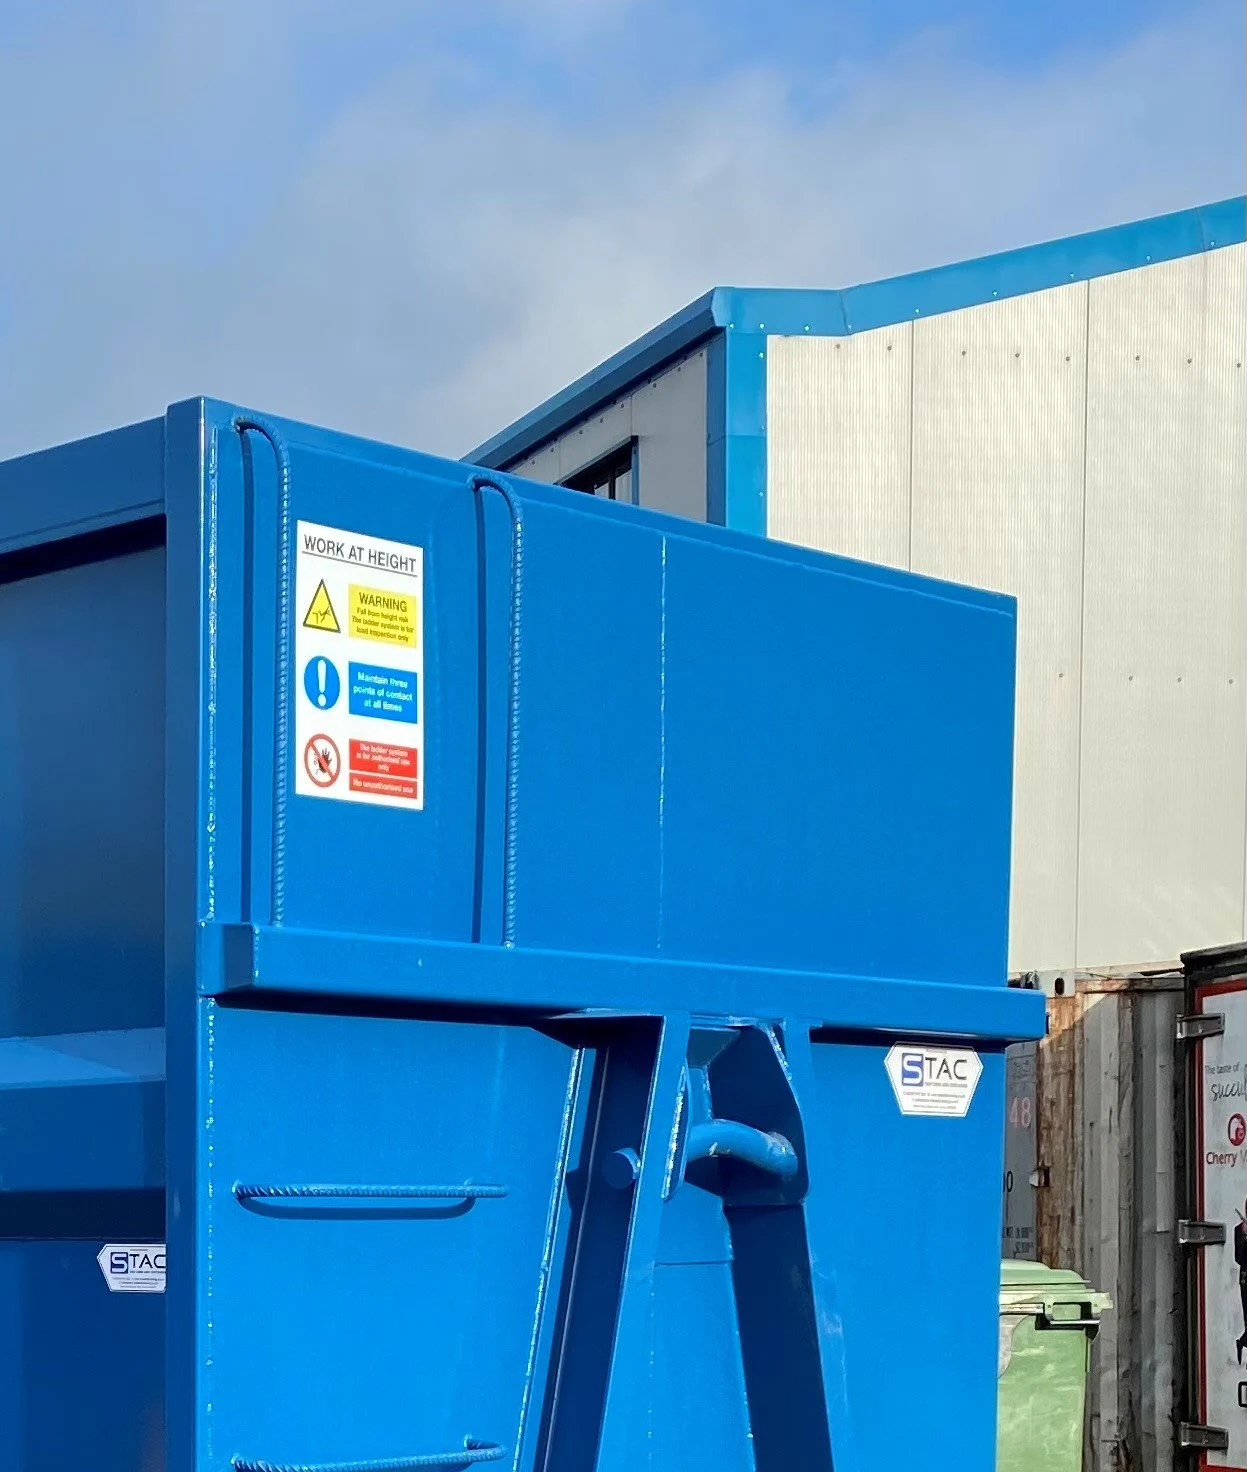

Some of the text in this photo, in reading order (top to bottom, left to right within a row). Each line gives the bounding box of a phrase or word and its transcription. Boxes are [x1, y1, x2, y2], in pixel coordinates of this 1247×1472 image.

[303, 534, 417, 573] WORK AT HEIGHT
[358, 592, 408, 613] WARNING
[351, 615, 362, 624] The
[362, 618, 380, 627] ladder
[380, 612, 398, 622] height
[397, 634, 409, 642] only
[357, 671, 389, 685] Maintain
[353, 685, 413, 702] points of contact
[363, 699, 403, 713] at all times
[901, 1052, 968, 1087] STAC
[1009, 1096, 1031, 1129] 48
[1206, 1151, 1238, 1168] Cherry
[110, 1251, 166, 1274] STAC
